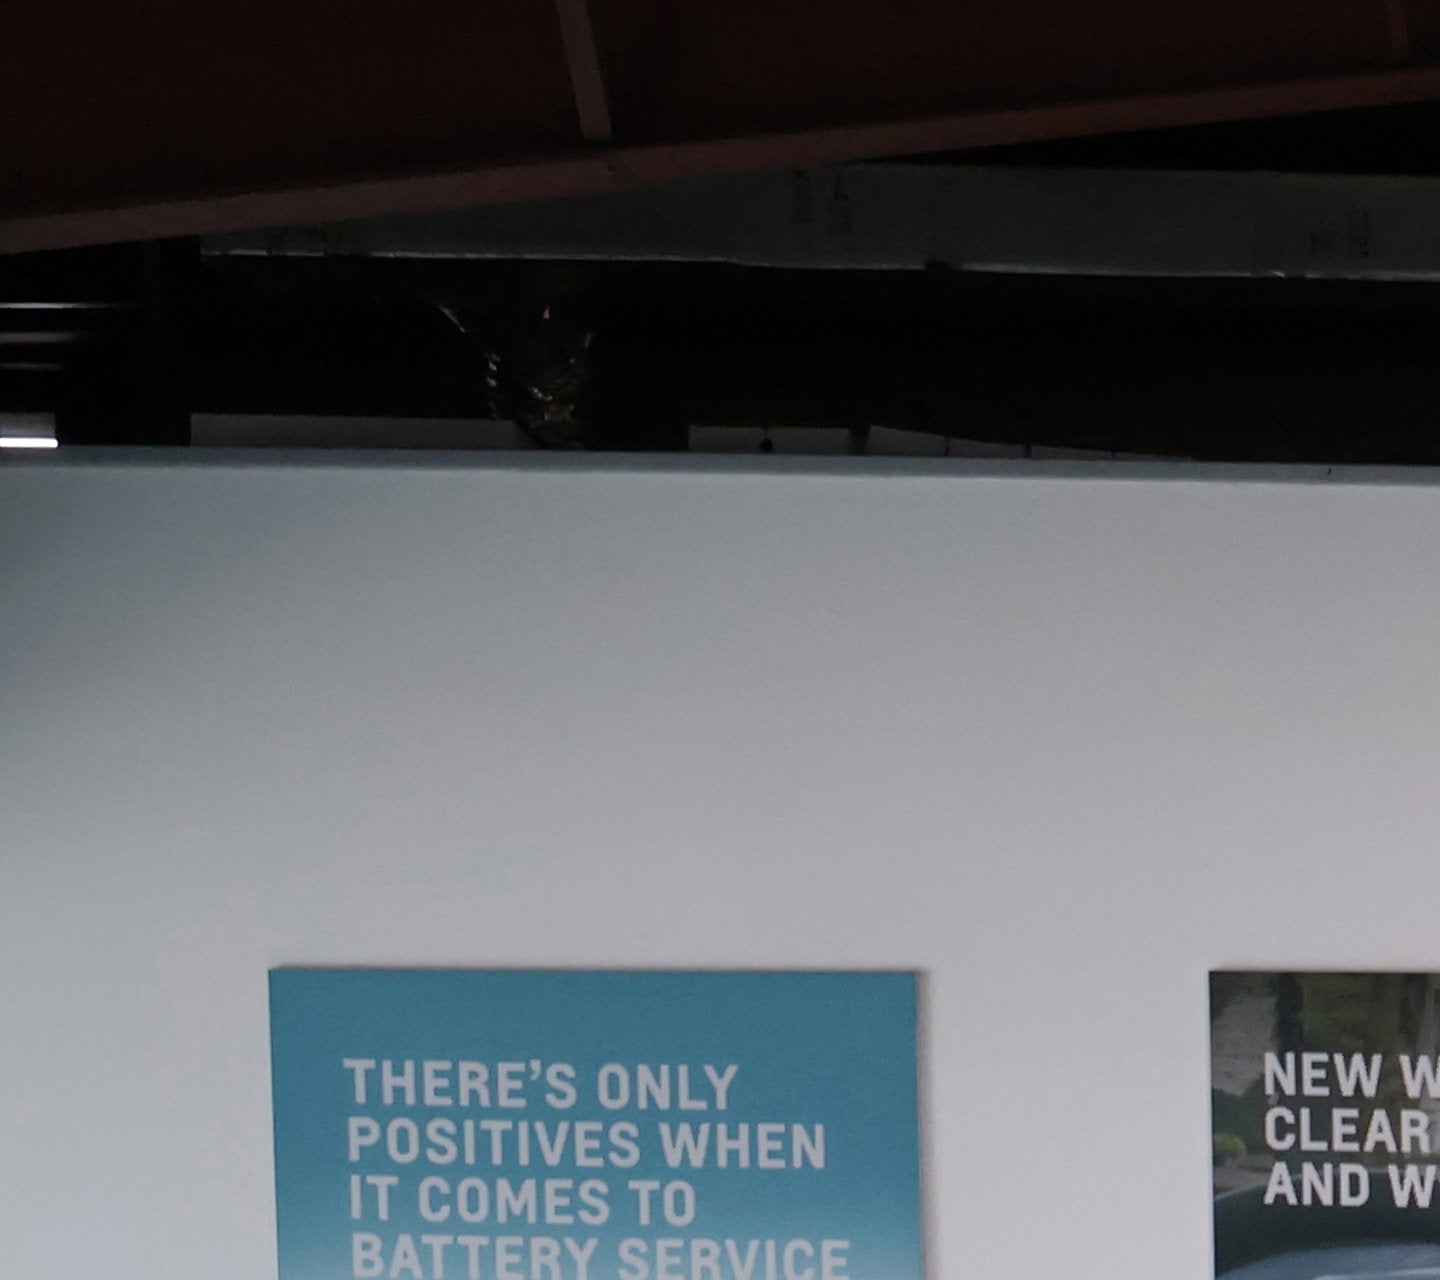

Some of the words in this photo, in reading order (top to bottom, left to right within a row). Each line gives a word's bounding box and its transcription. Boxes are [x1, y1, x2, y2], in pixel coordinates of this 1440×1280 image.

[343, 1057, 579, 1109] THERE'S
[597, 1062, 739, 1111] ONLY
[1264, 1051, 1382, 1098] NEW
[346, 1116, 642, 1167] POSITIVES
[658, 1121, 826, 1169] WHEN
[1264, 1106, 1431, 1153] CLEAR
[349, 1173, 399, 1221] IT
[418, 1175, 611, 1225] COMES
[628, 1179, 698, 1227] TO
[1264, 1161, 1371, 1207] AND
